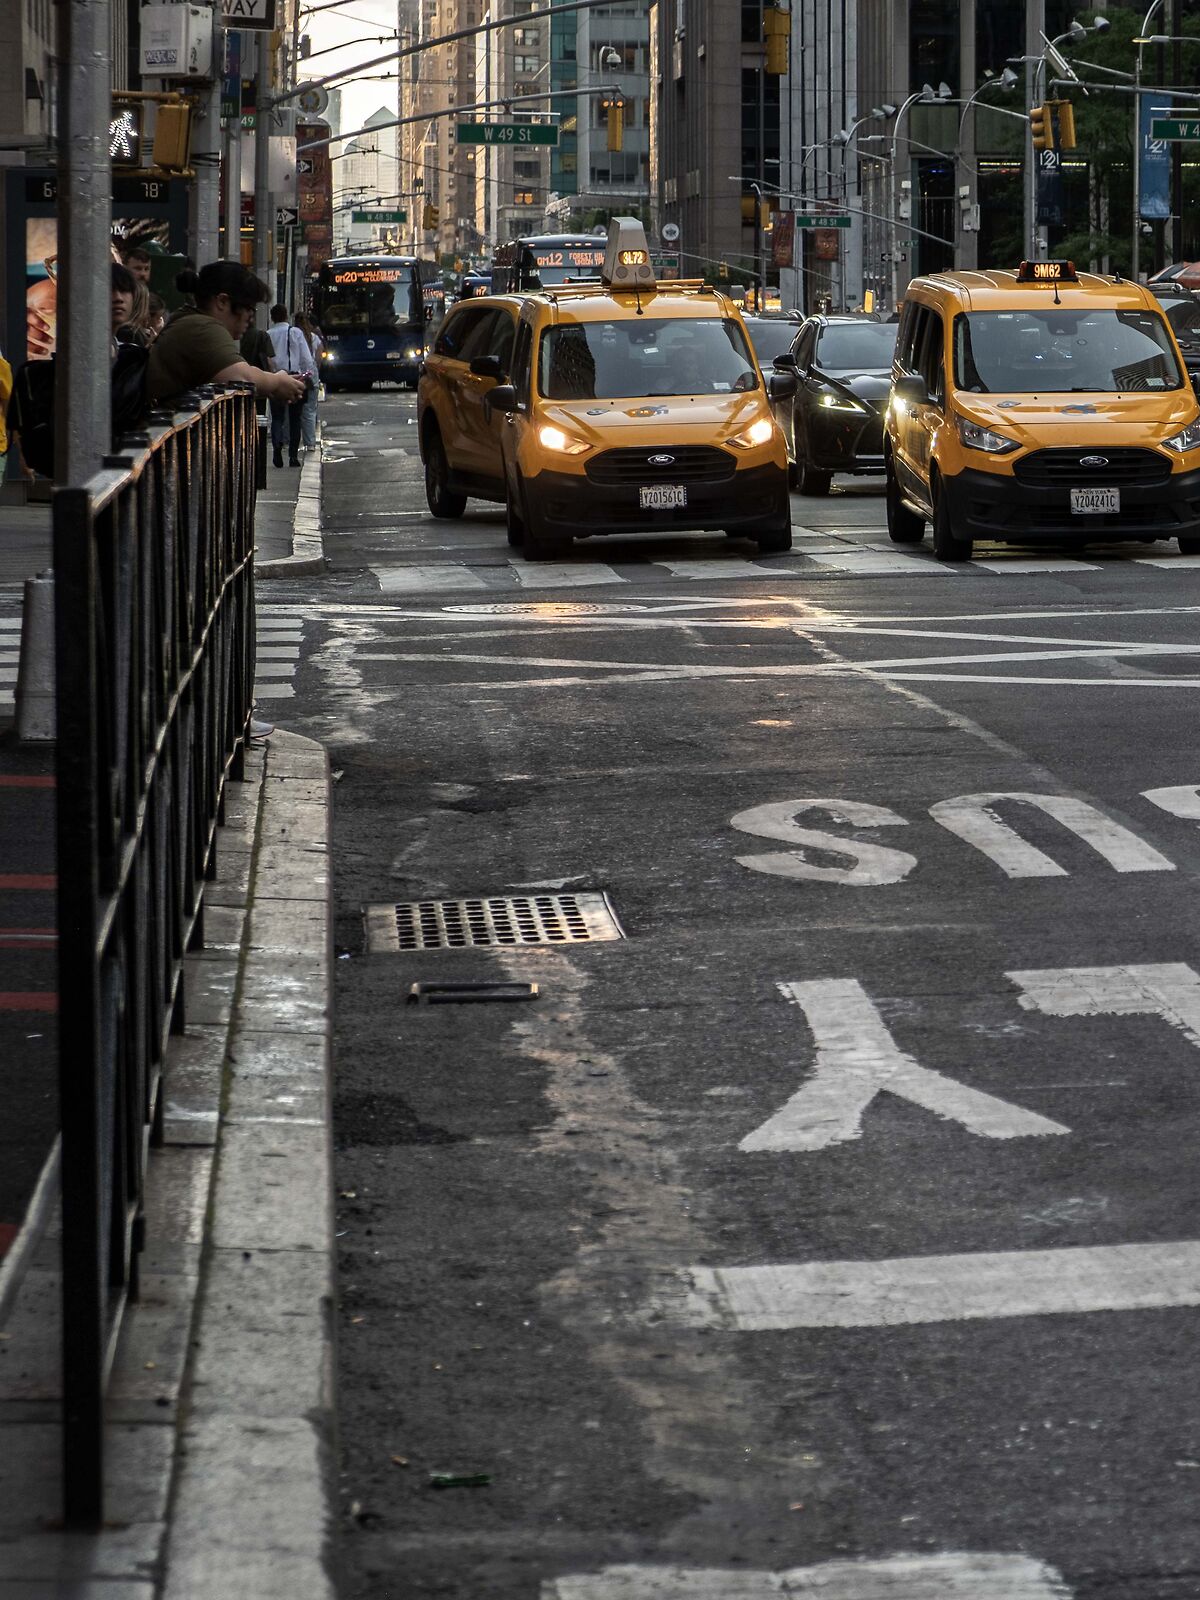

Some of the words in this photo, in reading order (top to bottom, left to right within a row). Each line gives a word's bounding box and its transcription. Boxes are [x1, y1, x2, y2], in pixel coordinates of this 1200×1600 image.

[241, 115, 253, 127] 49
[484, 127, 494, 140] W
[498, 126, 513, 140] 49
[519, 126, 532, 141] St
[1178, 123, 1188, 136] W
[367, 213, 373, 221] W
[810, 217, 817, 225] W
[829, 217, 837, 226] St
[623, 251, 643, 265] 3L72
[1034, 264, 1061, 278] 9M62
[643, 490, 683, 504] Y201561C
[1075, 494, 1115, 508] Y204241C
